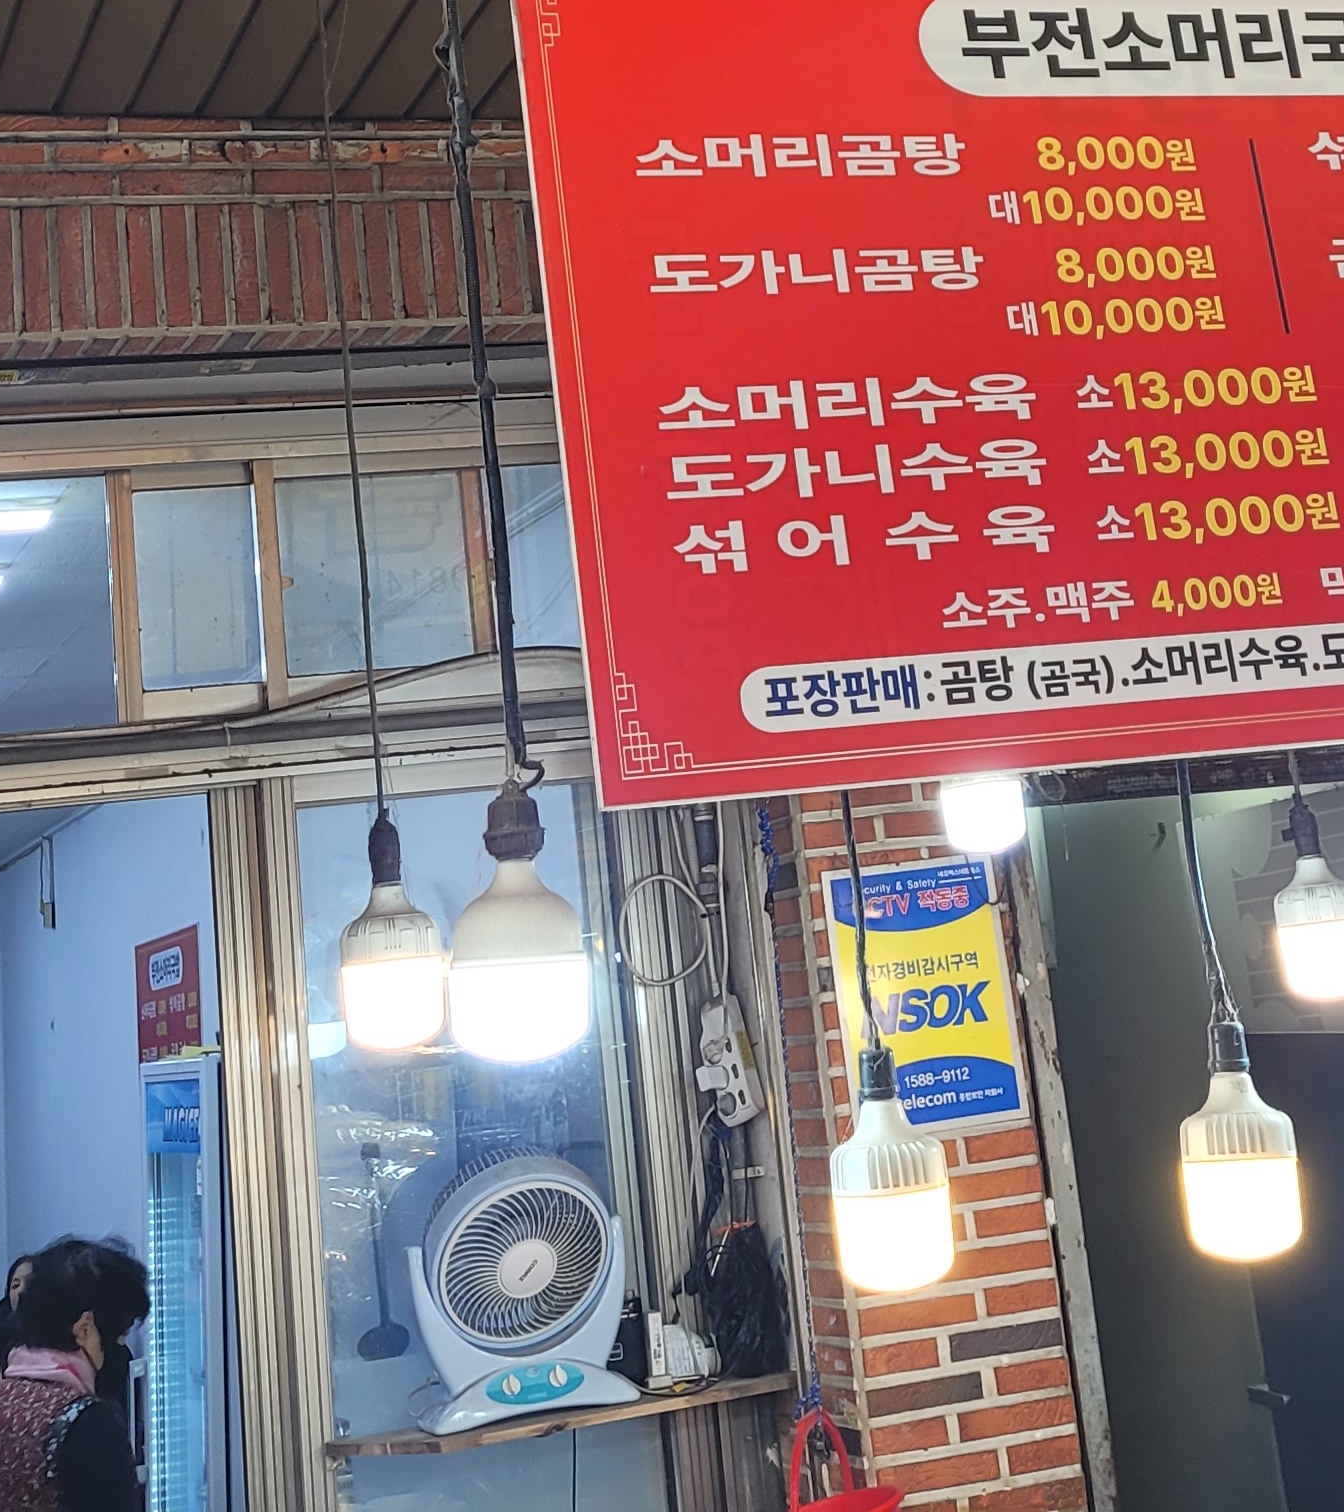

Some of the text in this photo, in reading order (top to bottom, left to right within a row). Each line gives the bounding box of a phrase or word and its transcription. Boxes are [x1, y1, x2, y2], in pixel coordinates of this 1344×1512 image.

[636, 134, 1196, 177] 소머리곰탕 8,000원
[989, 186, 1205, 225] 대10,000원
[650, 246, 1216, 294] 도가니곰탕 8,000원
[1007, 296, 1225, 339] 대10,000원
[659, 374, 1036, 429] 소머리수육
[1077, 365, 1317, 414] 소13,000원
[667, 439, 1046, 499] 도가니수육
[1088, 428, 1329, 478] 소13,000원
[1097, 492, 1340, 544] 소13,000원
[1152, 573, 1283, 616] 4,000원
[862, 877, 937, 895] curity & Safety
[864, 884, 970, 918] CTV 작동중
[861, 980, 991, 1039] NSOK
[904, 1067, 971, 1089] 1588-9112
[902, 1091, 956, 1110] elecom
